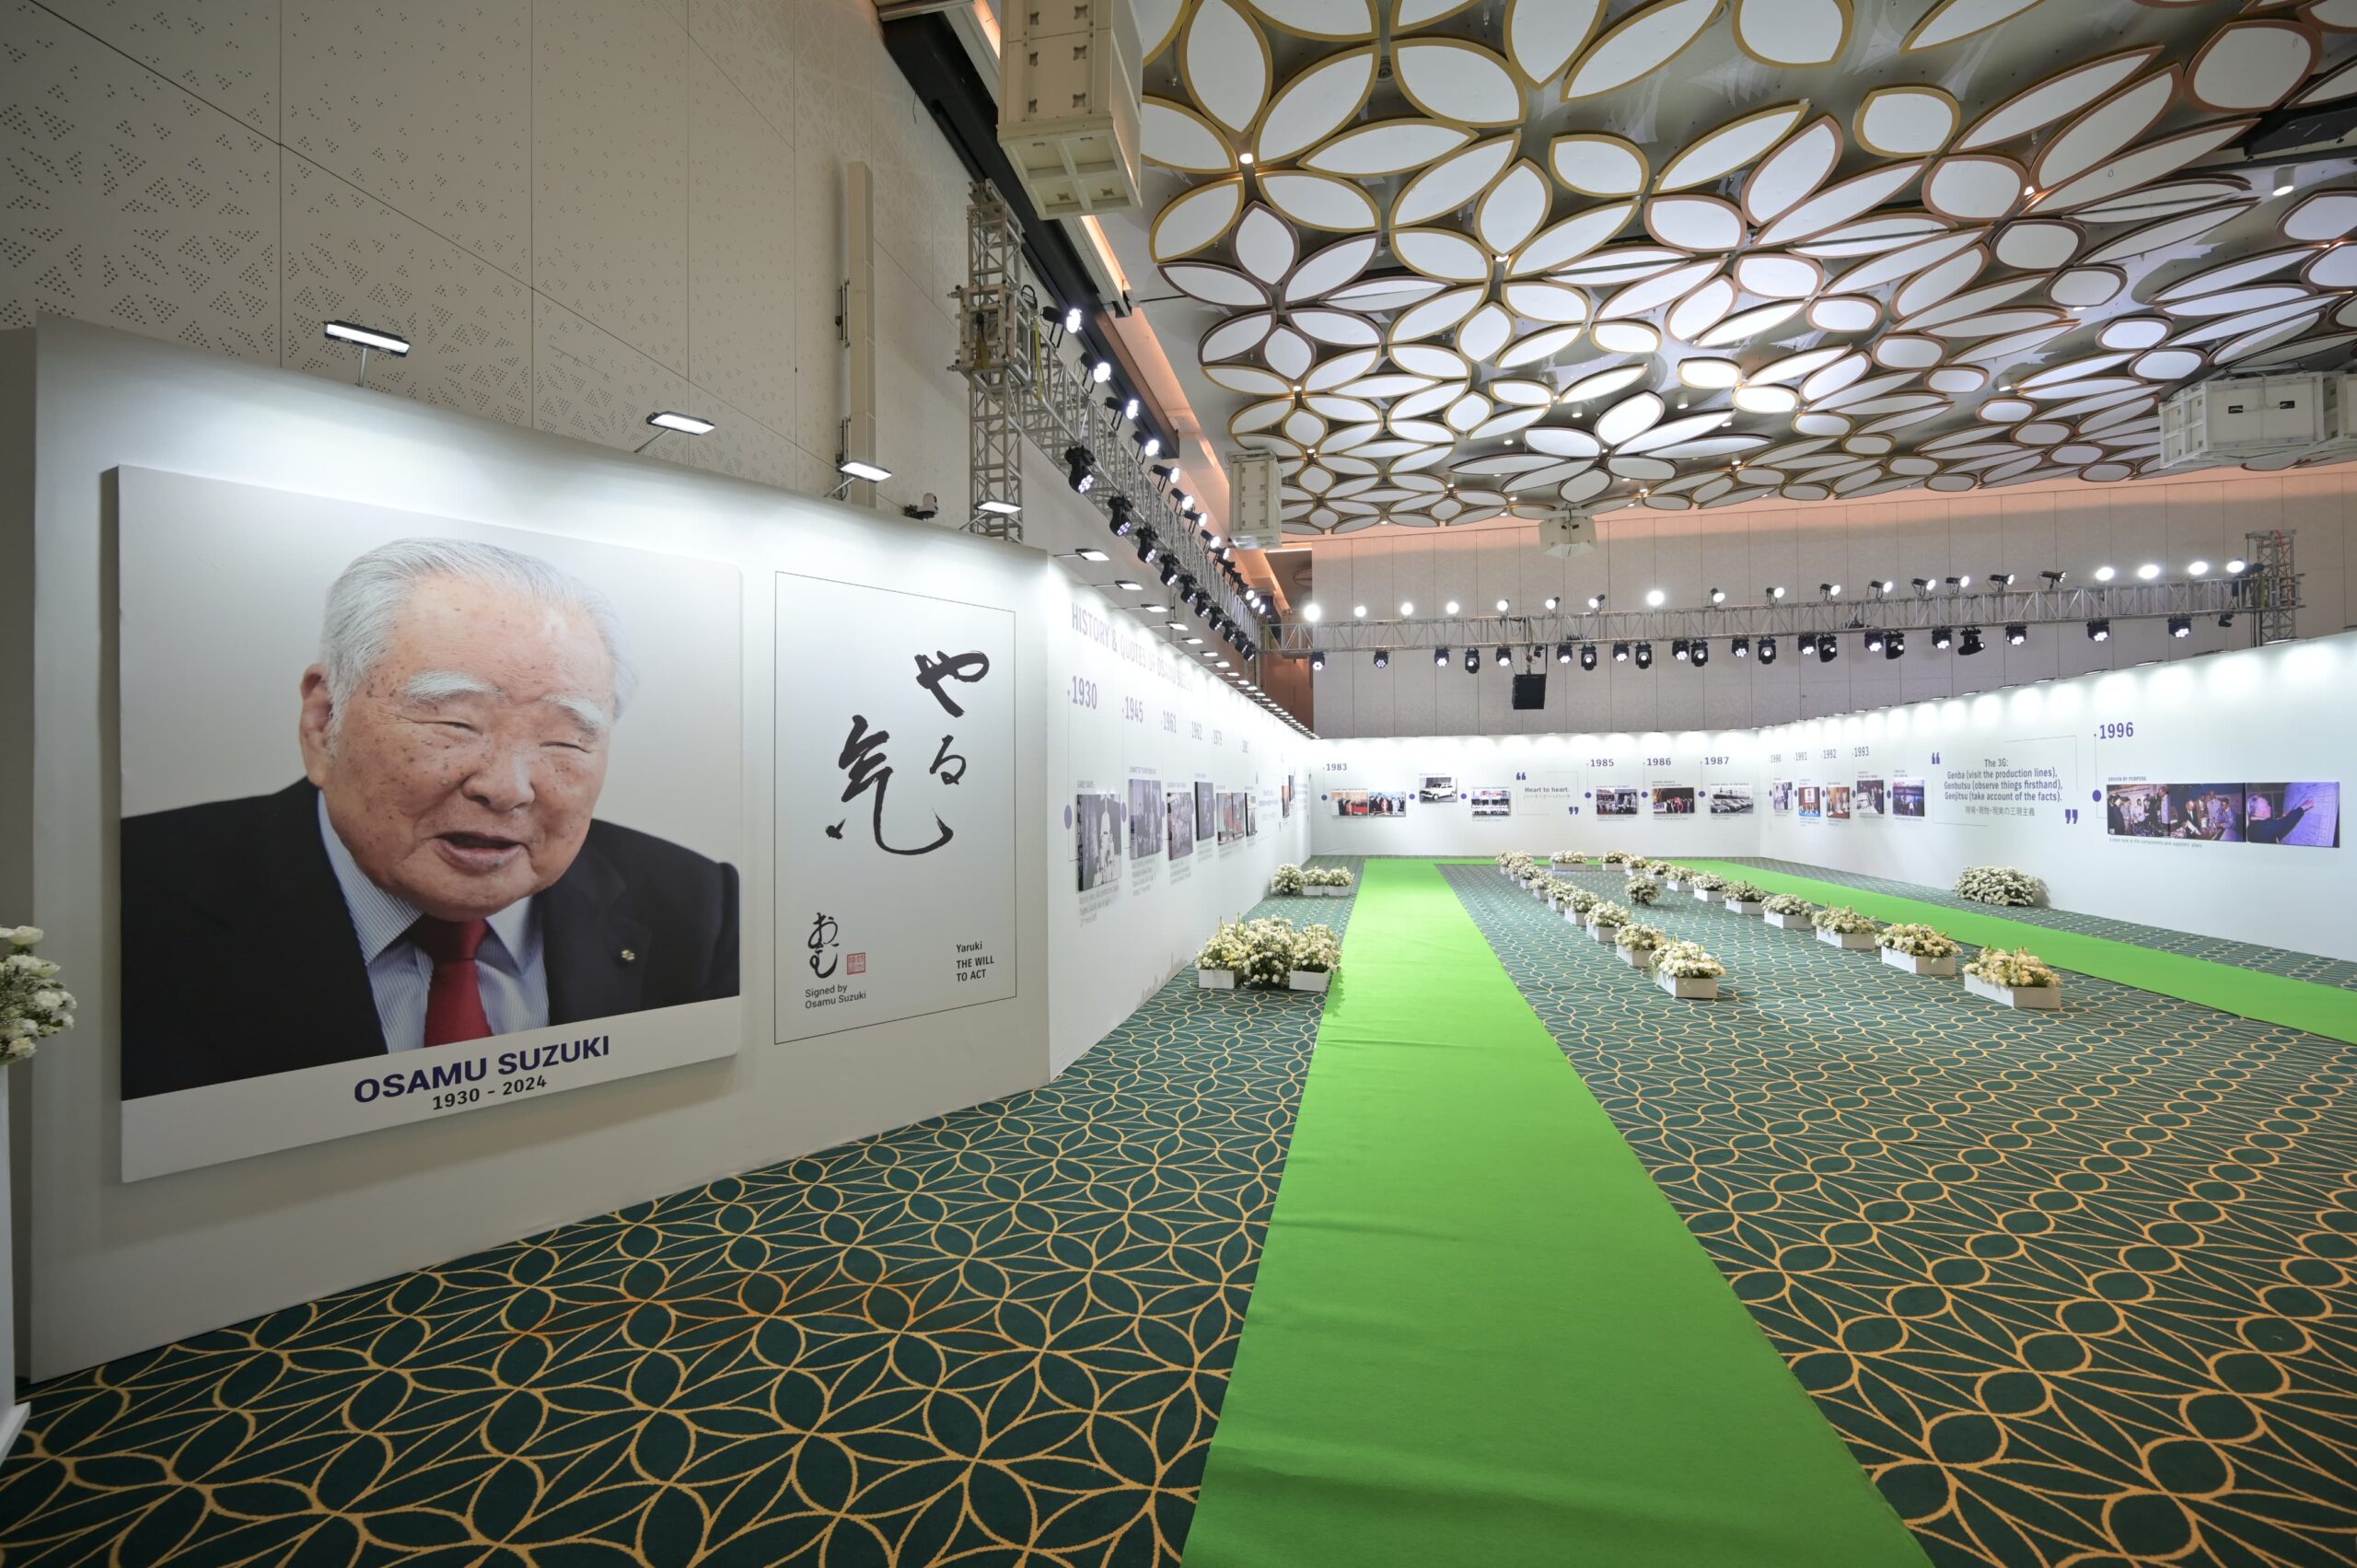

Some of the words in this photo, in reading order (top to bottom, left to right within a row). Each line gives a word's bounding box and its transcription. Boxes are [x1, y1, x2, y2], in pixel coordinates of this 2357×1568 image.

[1072, 603, 1109, 648] HISTORY
[1112, 629, 1119, 654] &
[1120, 633, 1147, 668] QUOTES
[1073, 675, 1097, 710] 1930
[1125, 695, 1144, 724] 1945
[1163, 710, 1177, 734] 1961
[2099, 721, 2134, 740] 1996
[1823, 749, 1837, 760] 1992
[1854, 746, 1870, 757] 1993
[1326, 762, 1348, 772] 1983
[1590, 759, 1614, 767] 1985
[1646, 757, 1672, 766] 1986
[1704, 756, 1729, 765] 1987
[1984, 759, 1996, 768] The
[1997, 758, 2009, 767] 3G:
[1946, 771, 1965, 780] Genba
[1966, 770, 1981, 781] (visit
[1983, 771, 1993, 779] the
[1995, 769, 2032, 780] production
[2034, 766, 2058, 779] lines),
[1944, 781, 1971, 790] Genbutsu
[1972, 780, 1999, 791] (observe
[2001, 780, 2022, 791] things
[2024, 779, 2063, 791] firsthand),
[1945, 792, 1968, 802] Genjitsu
[1968, 792, 1985, 802] (take
[1986, 793, 2013, 801] account
[2014, 792, 2023, 801] of
[2024, 792, 2036, 801] the
[2038, 792, 2062, 802] facts).
[956, 940, 983, 954] Yaruki
[956, 958, 972, 970] THE
[974, 955, 995, 968] WILL
[956, 972, 968, 982] TO
[970, 969, 986, 981] ACT
[805, 985, 835, 999] Signed
[837, 984, 848, 993] by
[805, 996, 836, 1009] Osamu
[838, 991, 866, 1004] Suzuki
[354, 1057, 488, 1103] OSAMU
[497, 1035, 610, 1075] SUZUKI
[432, 1087, 480, 1110] 1930
[503, 1074, 548, 1096] 2024
